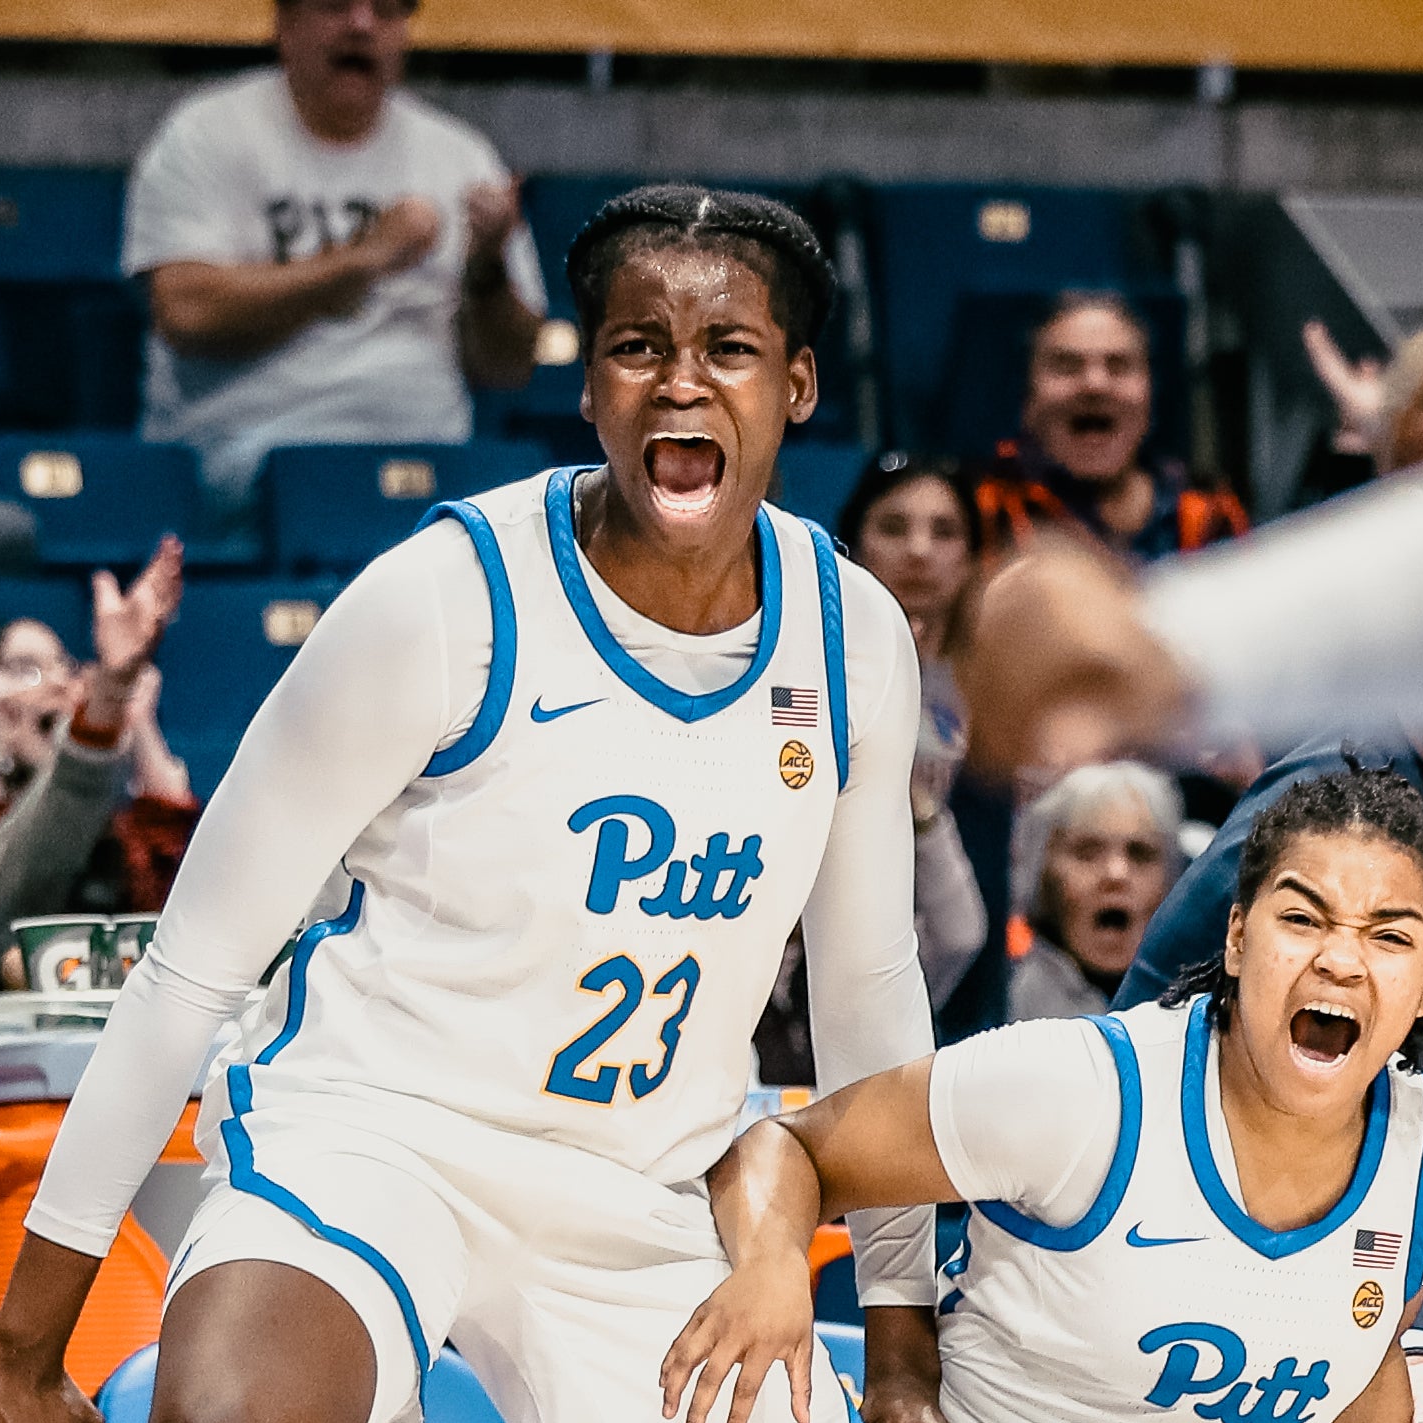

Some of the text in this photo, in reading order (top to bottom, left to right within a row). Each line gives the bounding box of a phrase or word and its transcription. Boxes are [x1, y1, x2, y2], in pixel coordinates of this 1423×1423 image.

[782, 756, 812, 768] ACC
[567, 795, 764, 920] Pitt
[540, 950, 701, 1109] 23
[1356, 1296, 1383, 1308] ACC
